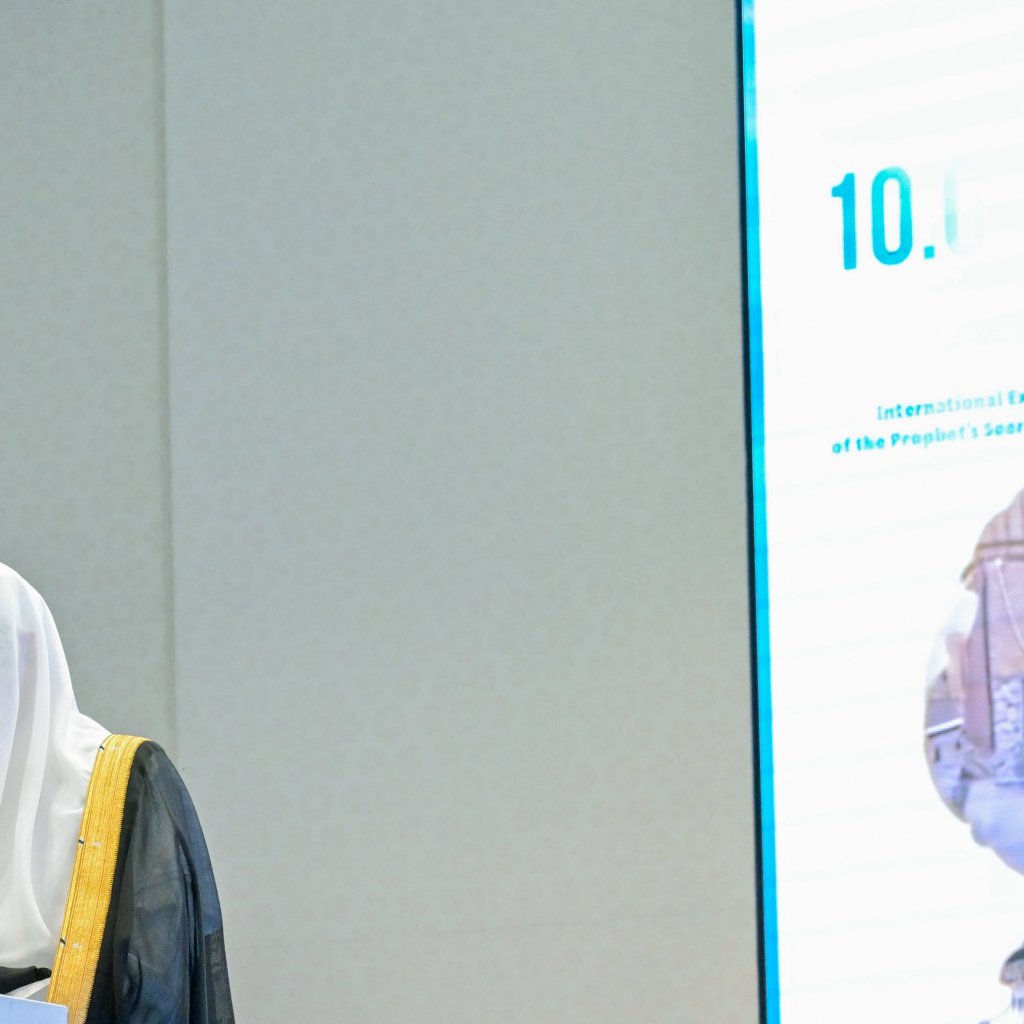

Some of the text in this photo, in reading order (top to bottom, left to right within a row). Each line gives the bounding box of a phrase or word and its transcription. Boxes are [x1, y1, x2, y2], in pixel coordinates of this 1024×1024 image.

[832, 437, 851, 454] of
[856, 436, 886, 452] the
[890, 423, 979, 448] Prophet's
